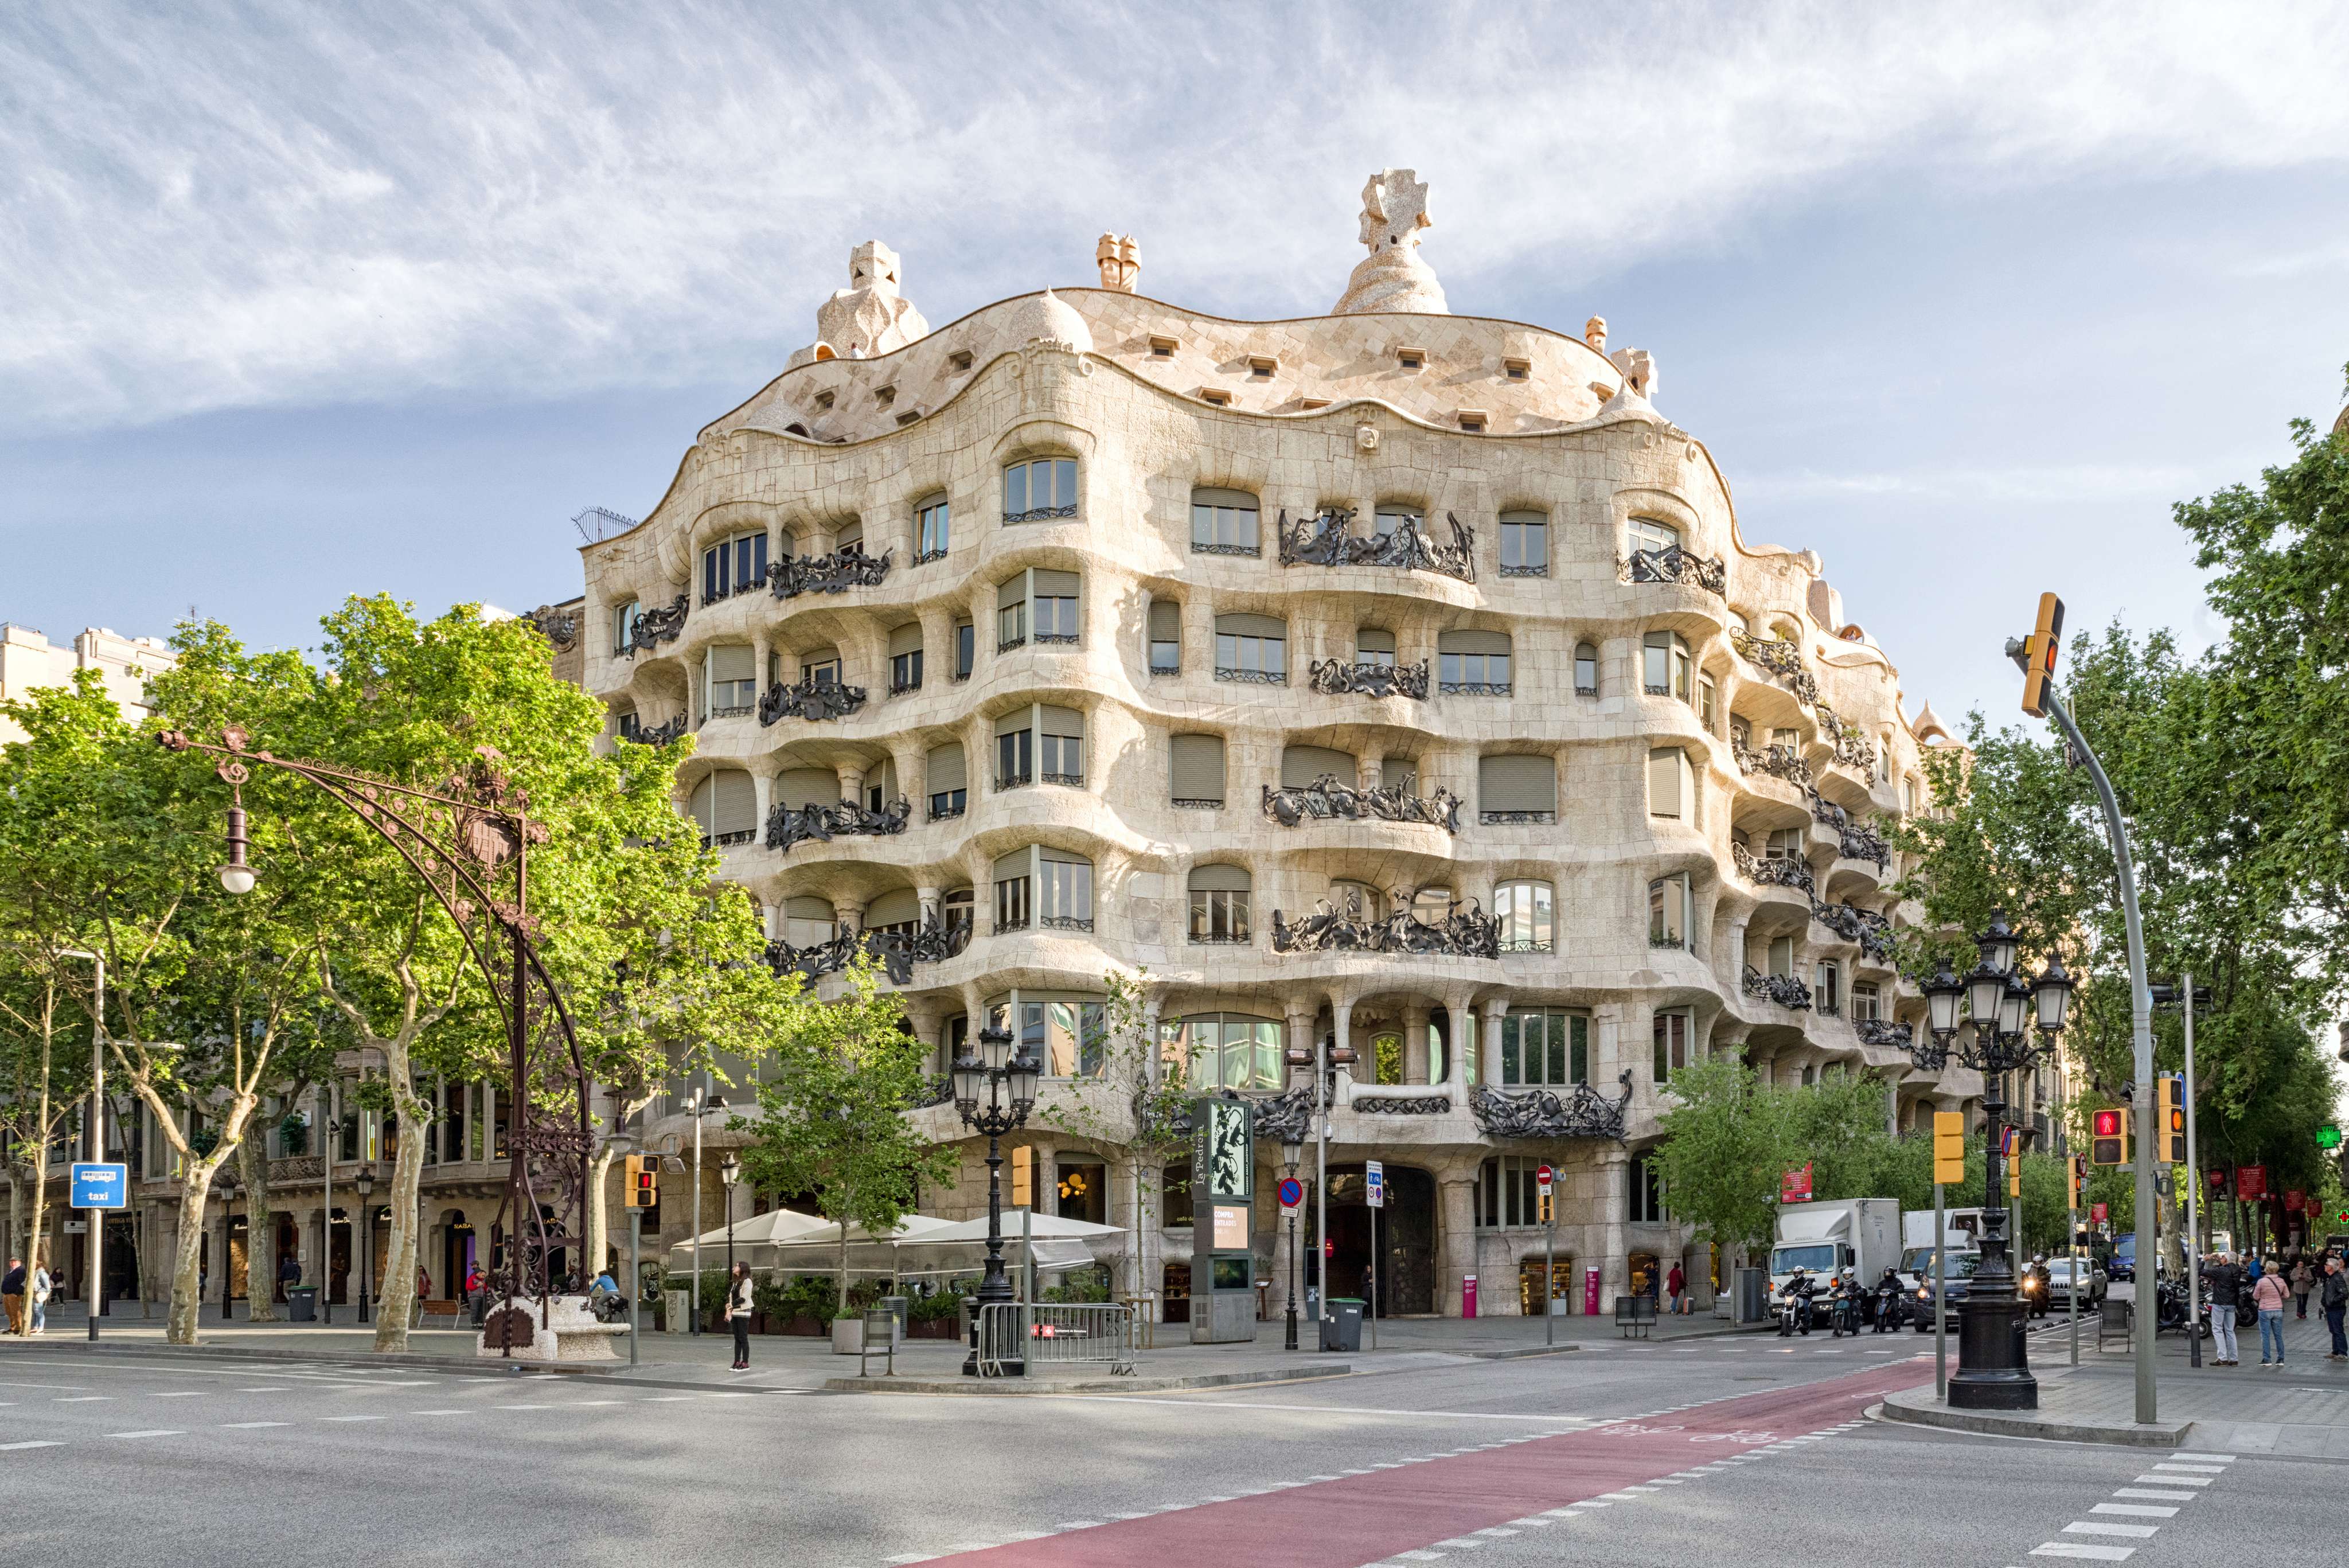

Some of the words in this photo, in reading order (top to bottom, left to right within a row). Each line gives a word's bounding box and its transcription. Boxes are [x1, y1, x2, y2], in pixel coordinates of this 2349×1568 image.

[1195, 1124, 1204, 1172] Pedrera
[1196, 1173, 1205, 1185] La
[88, 1192, 108, 1200] taxi
